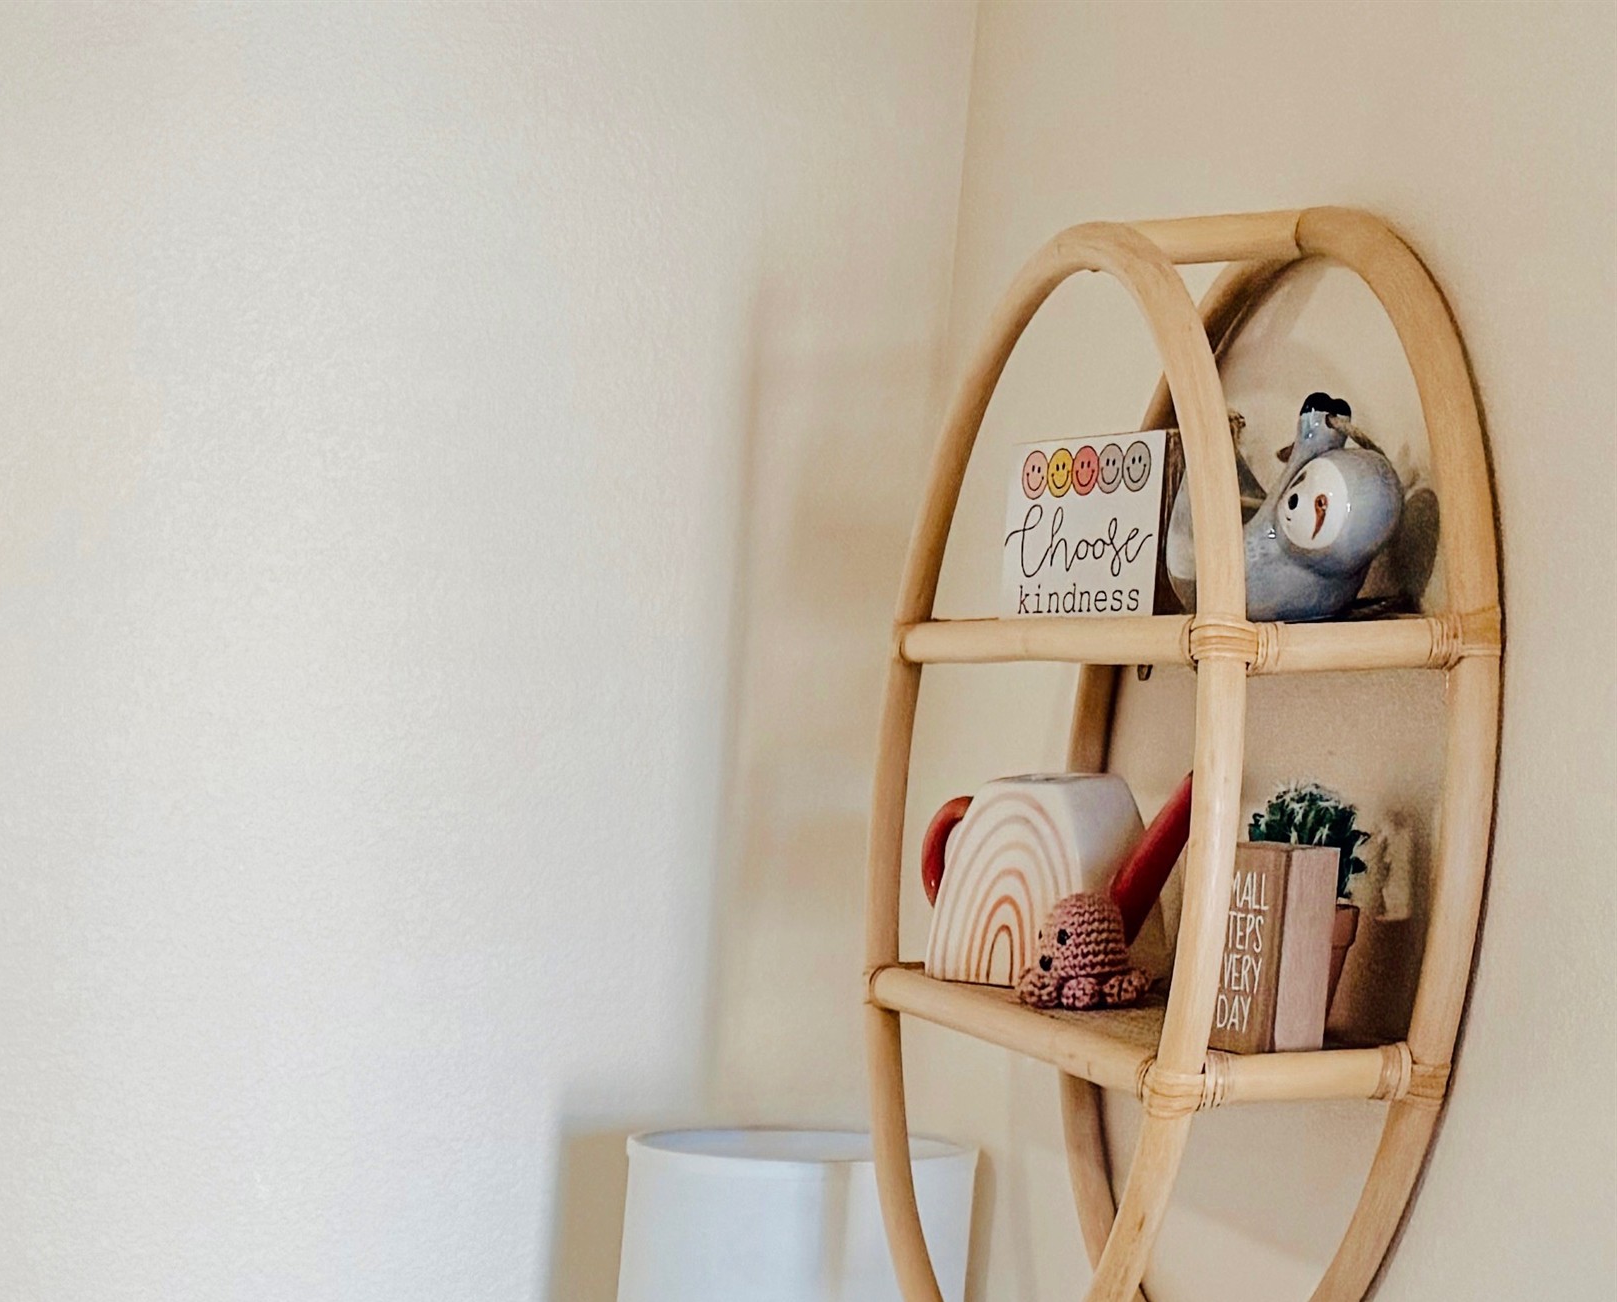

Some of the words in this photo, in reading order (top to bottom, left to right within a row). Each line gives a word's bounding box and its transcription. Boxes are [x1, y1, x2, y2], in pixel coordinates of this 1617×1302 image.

[1005, 504, 1153, 578] Choose
[1017, 586, 1140, 614] kindness
[1228, 911, 1264, 953] TEPS
[1222, 954, 1263, 994] VERY
[1216, 995, 1251, 1032] DAY
